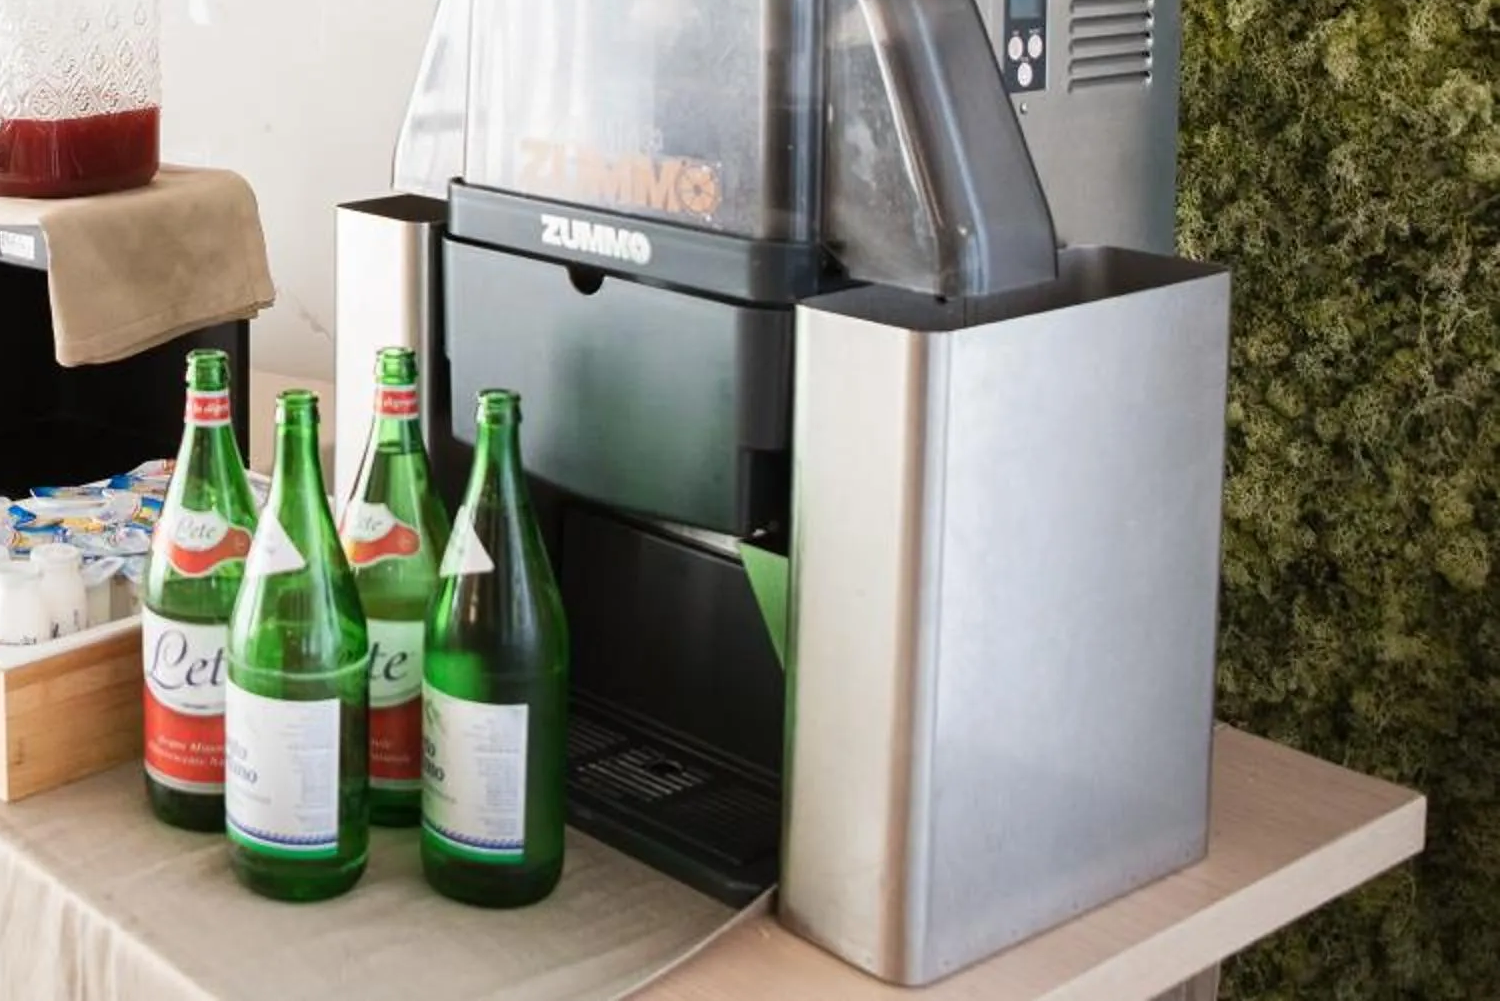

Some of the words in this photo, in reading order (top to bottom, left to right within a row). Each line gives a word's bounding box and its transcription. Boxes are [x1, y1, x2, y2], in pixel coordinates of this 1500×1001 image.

[518, 139, 722, 216] ZUMMO
[541, 213, 651, 265] ZUMMO
[150, 628, 224, 690] Let
